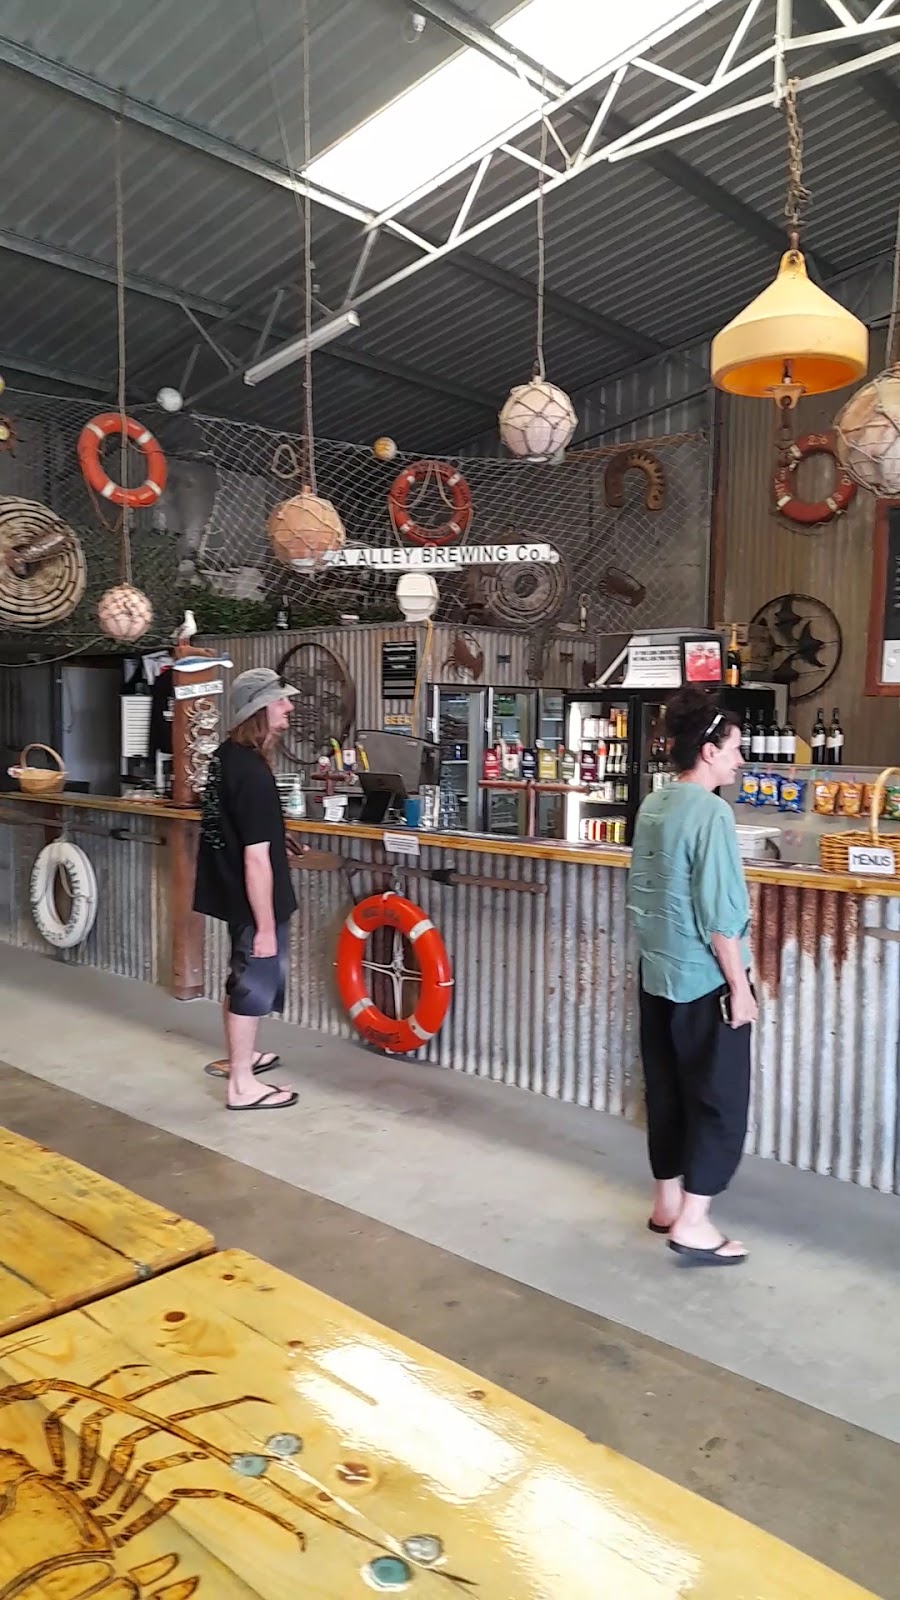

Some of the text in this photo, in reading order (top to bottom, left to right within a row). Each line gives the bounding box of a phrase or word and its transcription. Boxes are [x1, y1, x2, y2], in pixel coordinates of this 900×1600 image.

[358, 548, 413, 564] ALLEY
[422, 546, 508, 563] BREWING
[853, 853, 891, 866] MENUS
